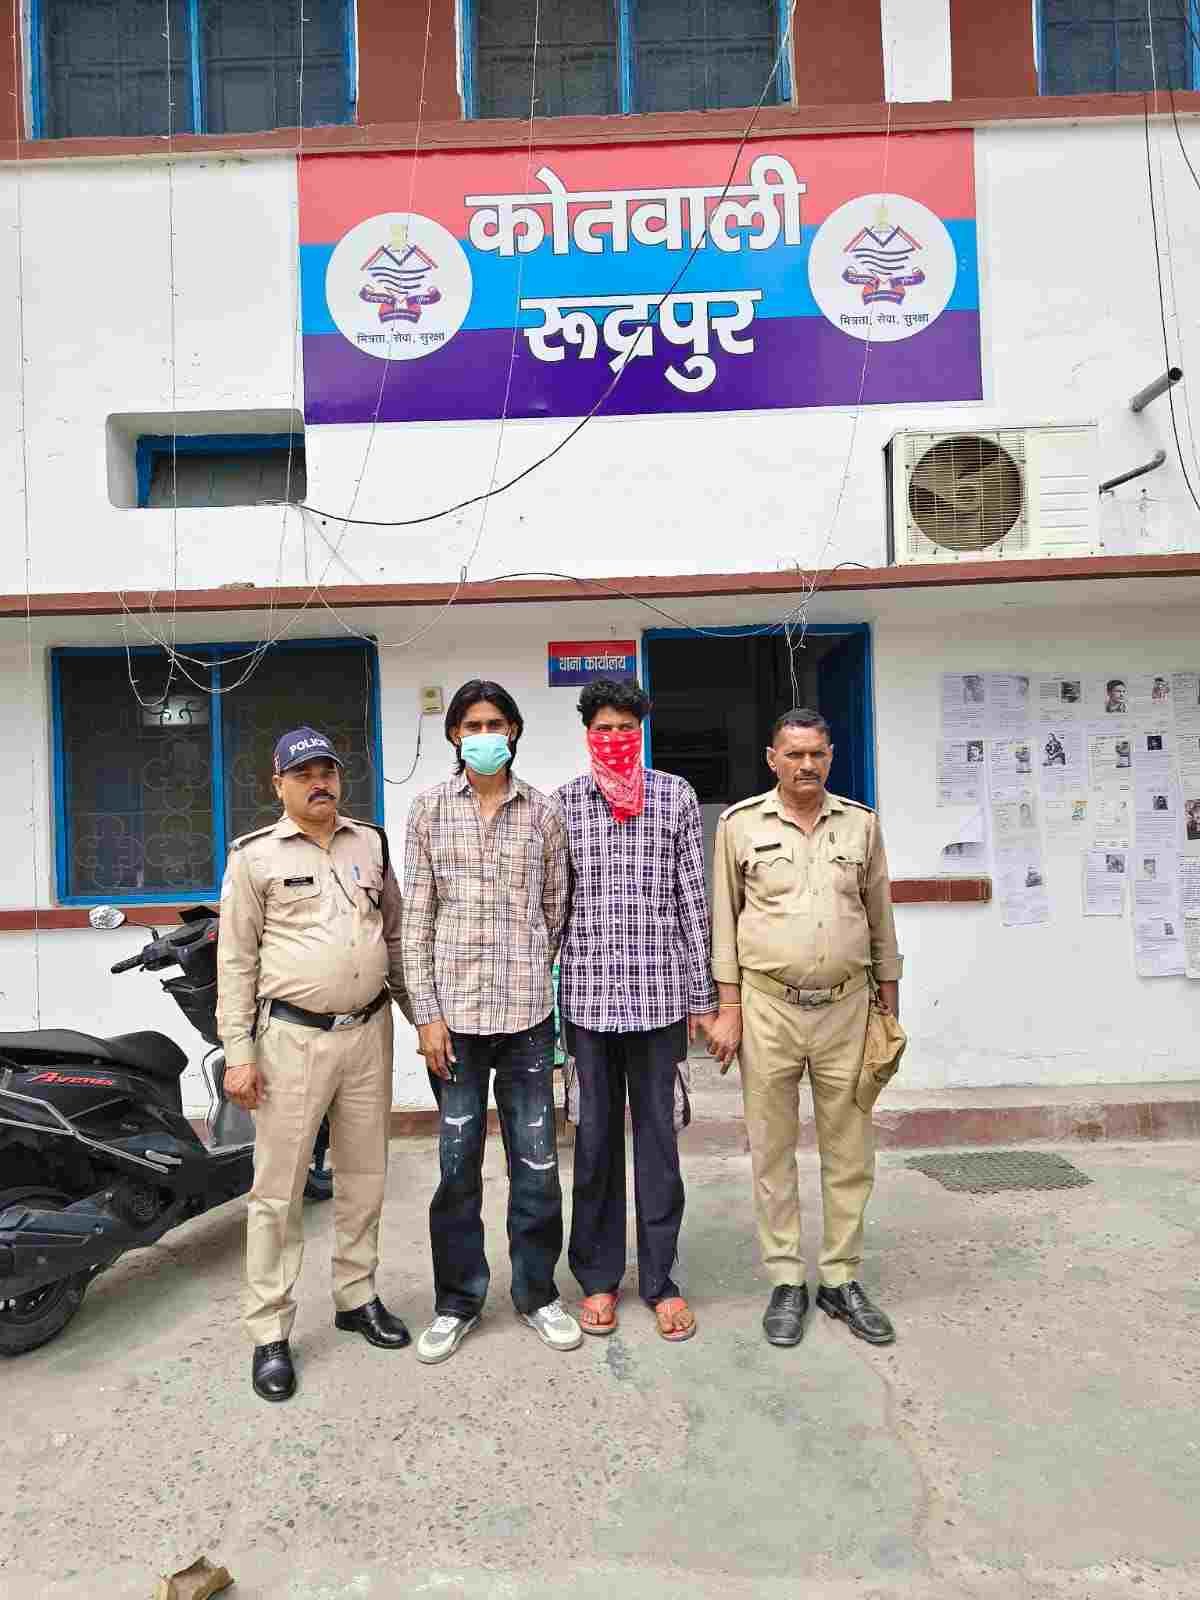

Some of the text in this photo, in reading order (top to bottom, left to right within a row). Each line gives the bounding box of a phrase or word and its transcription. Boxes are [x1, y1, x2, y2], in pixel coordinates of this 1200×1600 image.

[464, 153, 807, 257] कोतवाली
[519, 288, 764, 394] रूद्रपुर
[288, 737, 329, 760] POLICE
